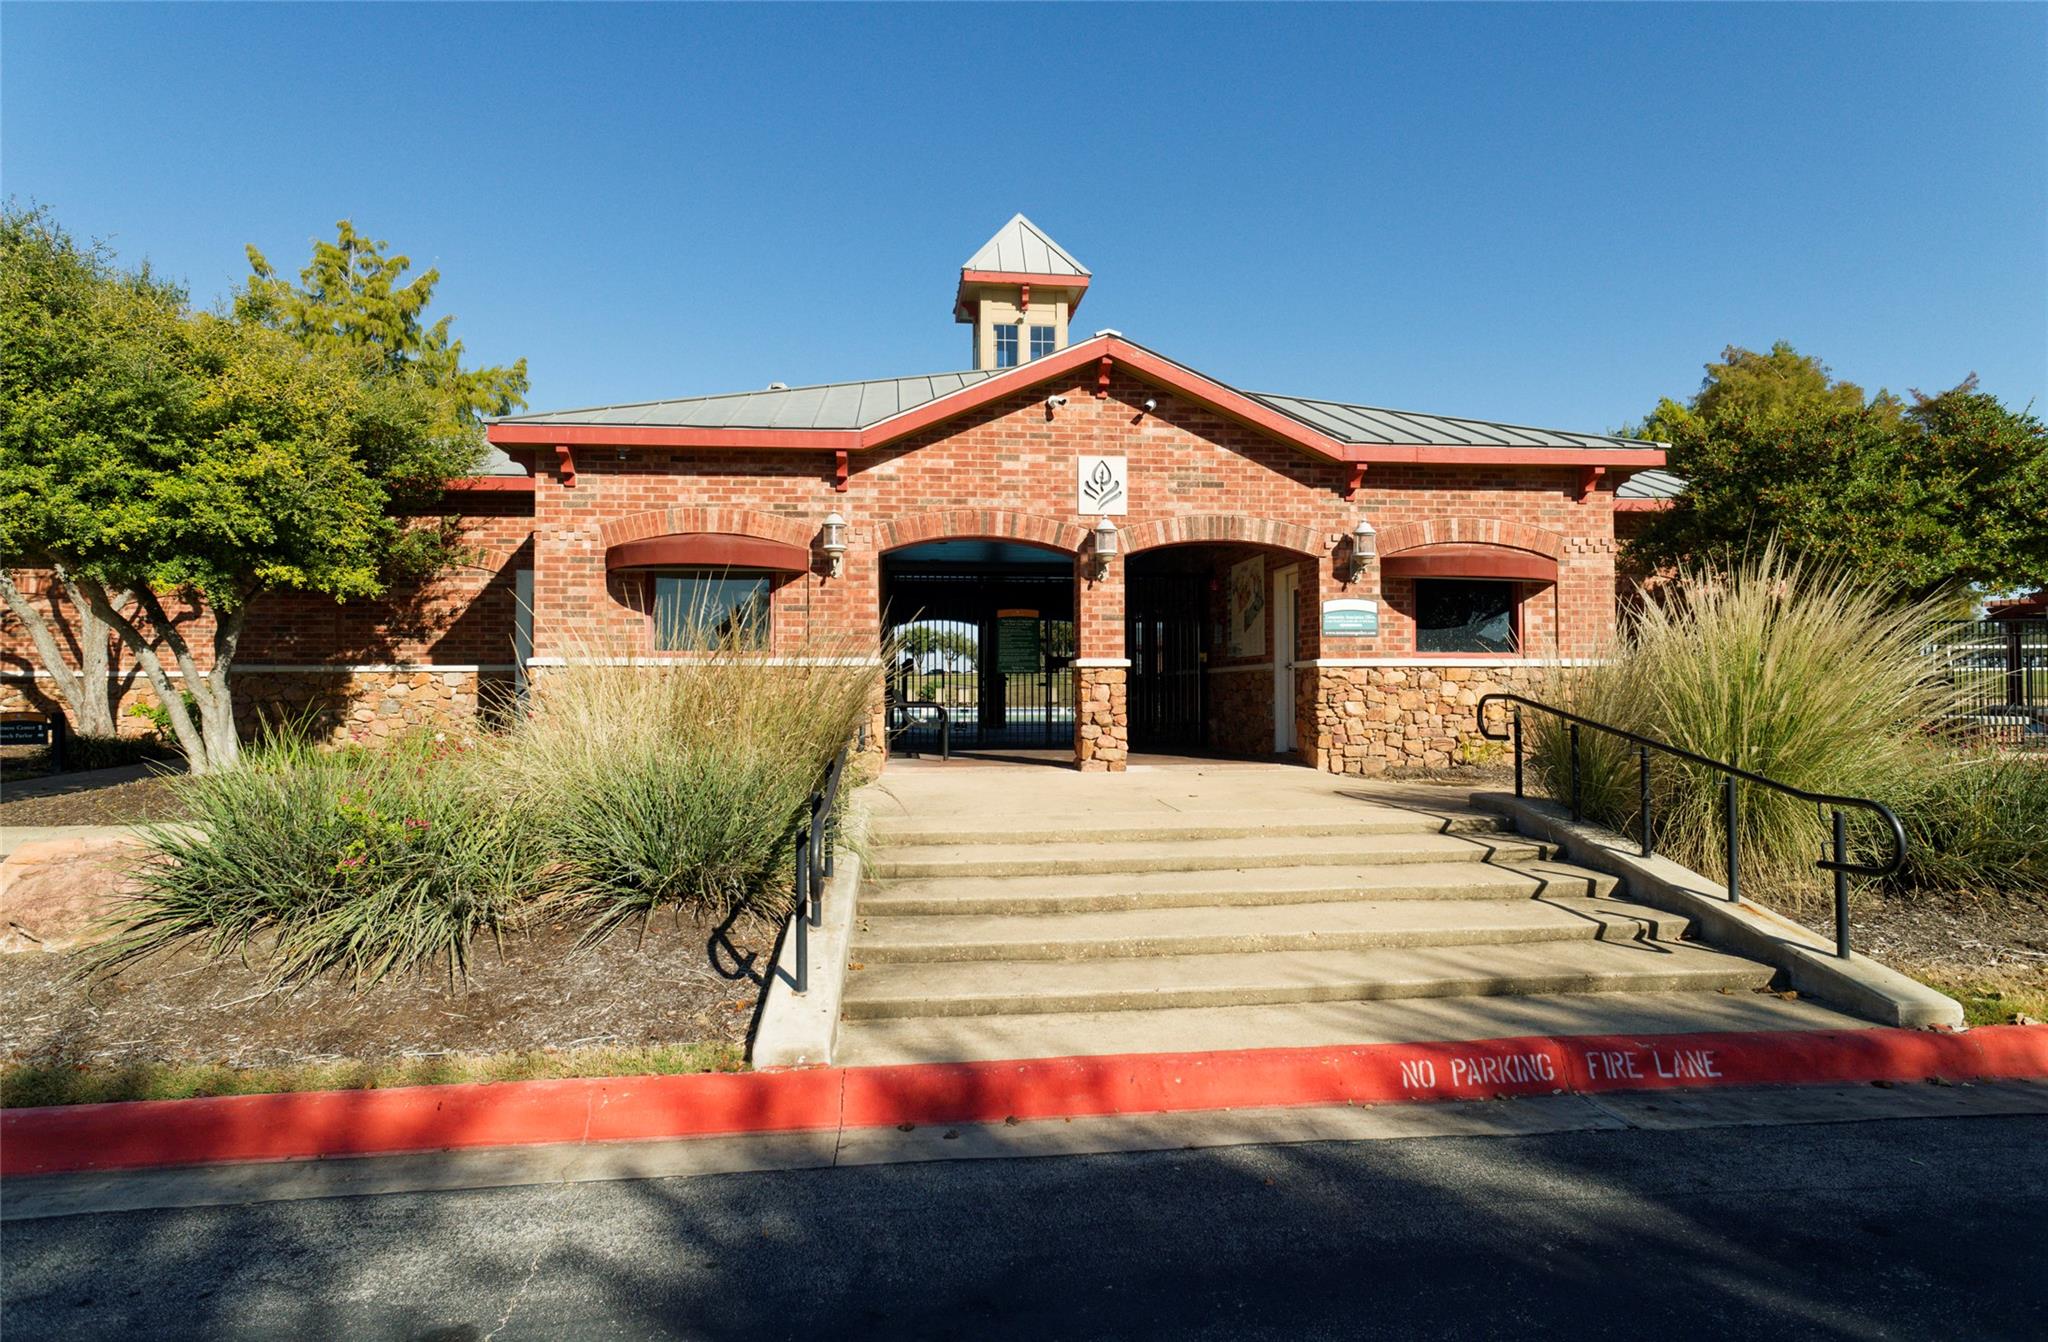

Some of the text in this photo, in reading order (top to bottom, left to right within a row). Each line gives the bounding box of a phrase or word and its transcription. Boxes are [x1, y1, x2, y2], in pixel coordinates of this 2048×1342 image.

[1401, 1049, 1722, 1088] NO PARKING FIRE LANE
